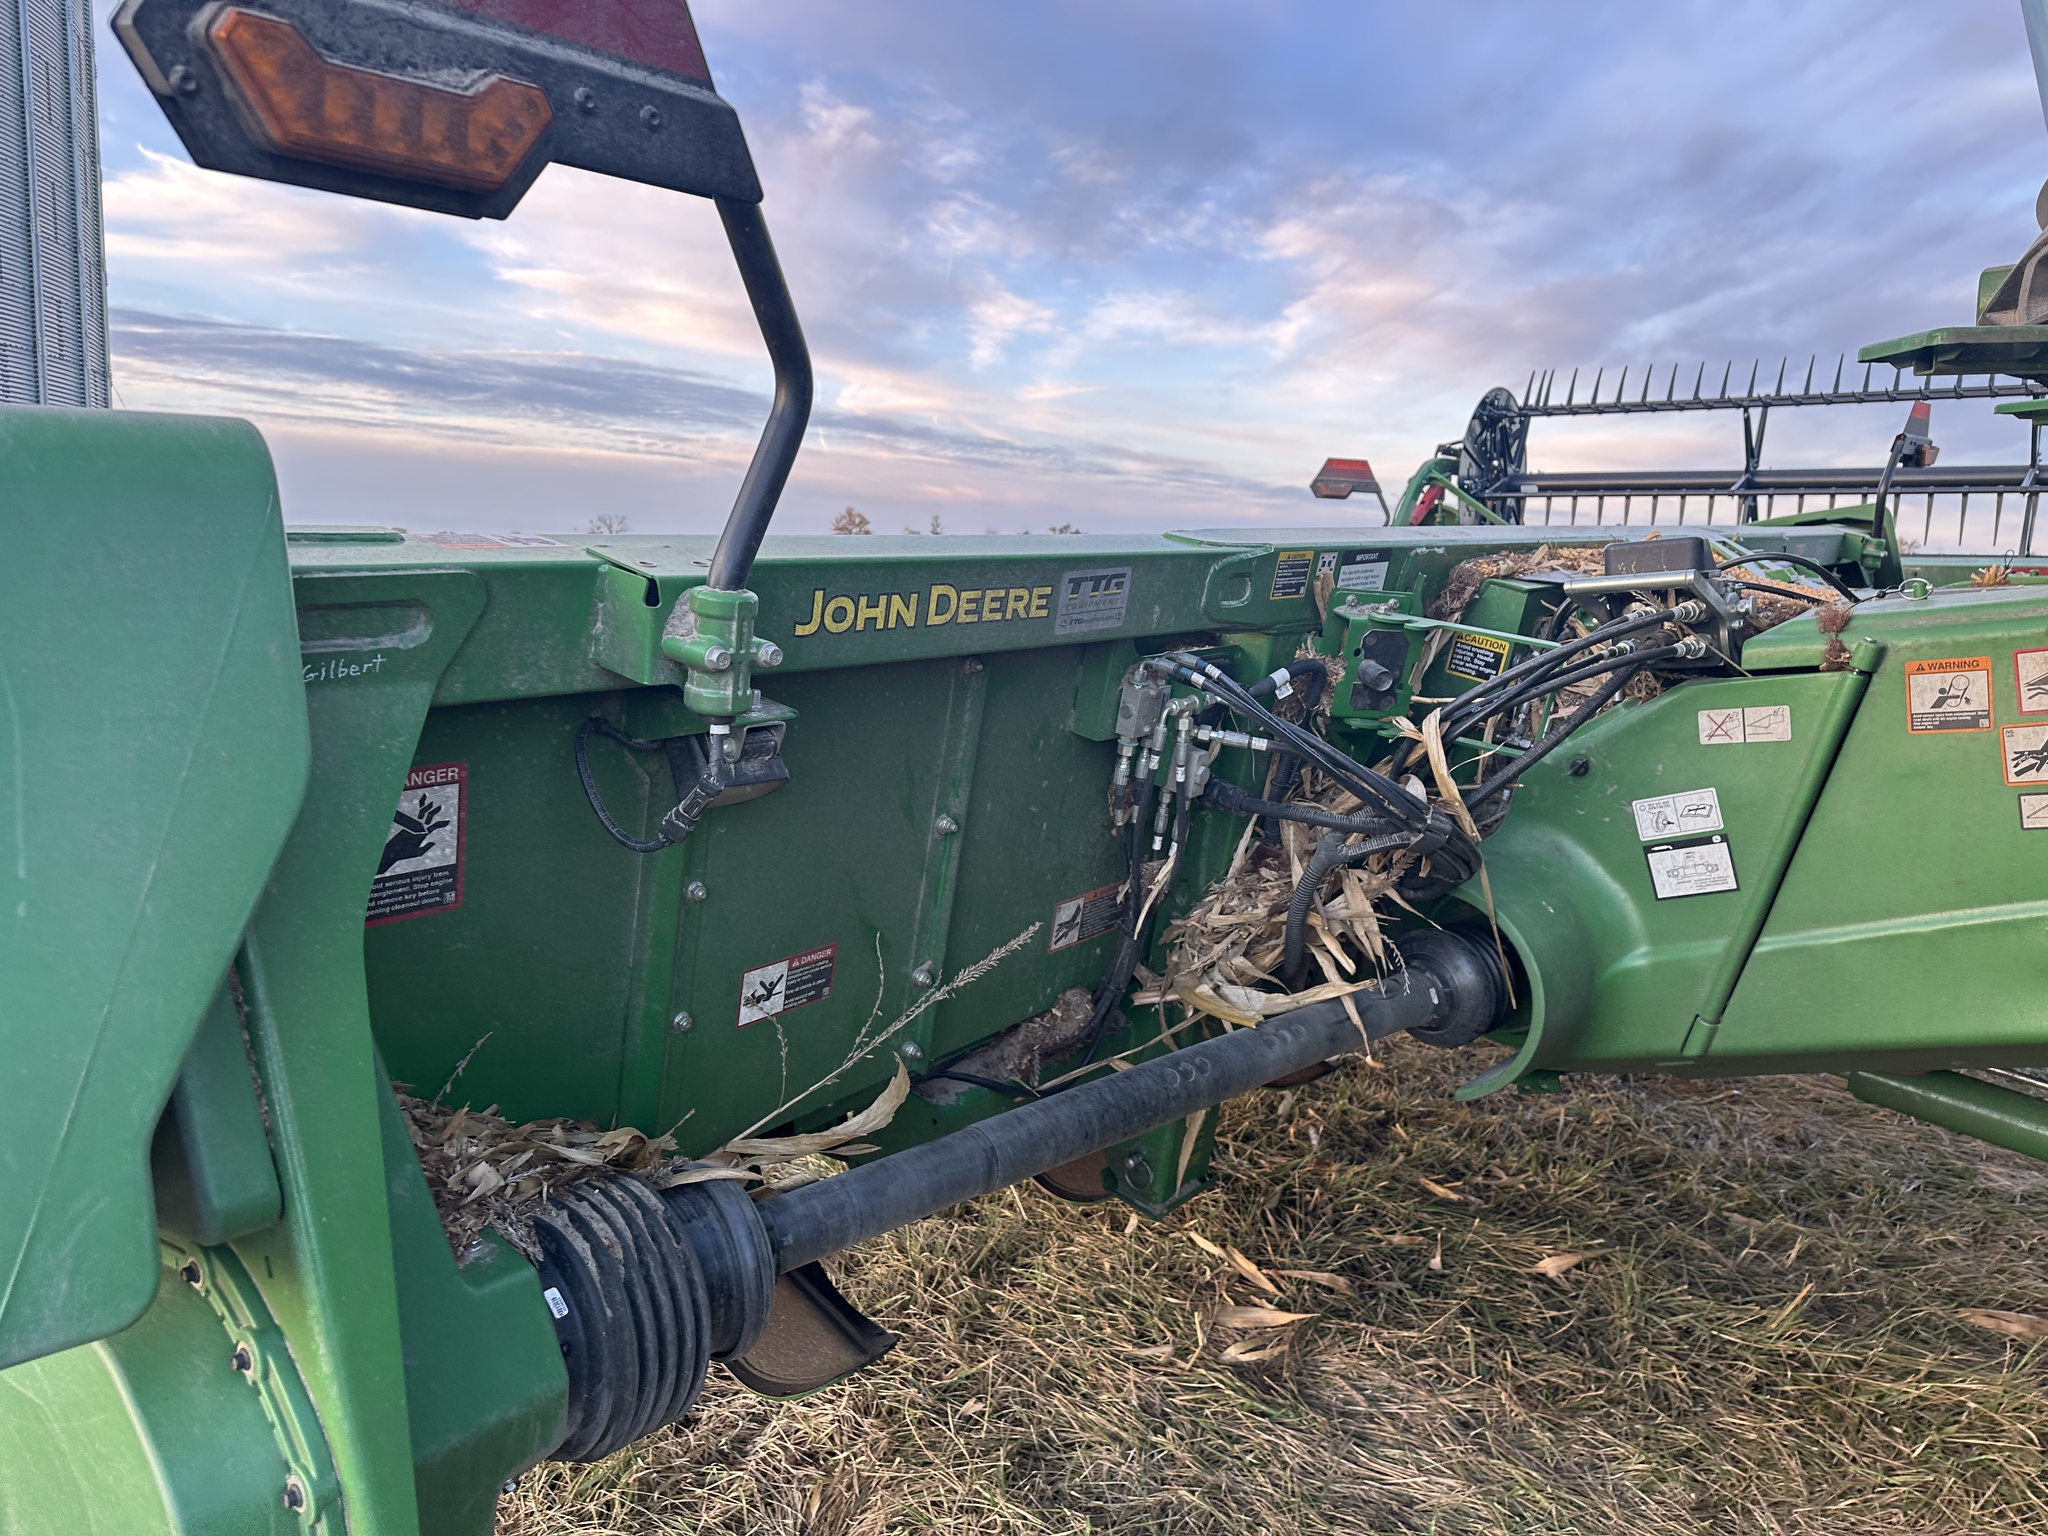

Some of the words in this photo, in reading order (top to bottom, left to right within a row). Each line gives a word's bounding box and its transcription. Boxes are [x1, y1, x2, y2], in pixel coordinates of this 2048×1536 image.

[1355, 553, 1379, 561] IMPORTANT
[1067, 573, 1127, 600] TTG
[794, 588, 919, 636] JOHN
[926, 583, 1053, 627] DEERE
[1066, 598, 1120, 610] EQUIPMENT
[1465, 634, 1506, 651] CAUTION
[1455, 648, 1474, 657] injuries.
[1477, 654, 1495, 662] Header
[1472, 647, 1494, 657] crushing
[302, 654, 387, 682] Gilbert
[1473, 659, 1485, 667] Stay
[1479, 666, 1496, 674] engine
[1928, 660, 1979, 670] WARNING
[1456, 666, 1476, 675] running.
[404, 767, 458, 786] NGER
[385, 878, 410, 887] serious
[412, 874, 432, 883] injury
[369, 887, 411, 898] tanglement.
[430, 878, 453, 887] engine
[376, 896, 403, 905] remove
[418, 889, 440, 897] before
[366, 906, 390, 916] pening
[391, 900, 420, 911] cleanout
[421, 896, 442, 904] doors.
[801, 949, 832, 964] DANGER
